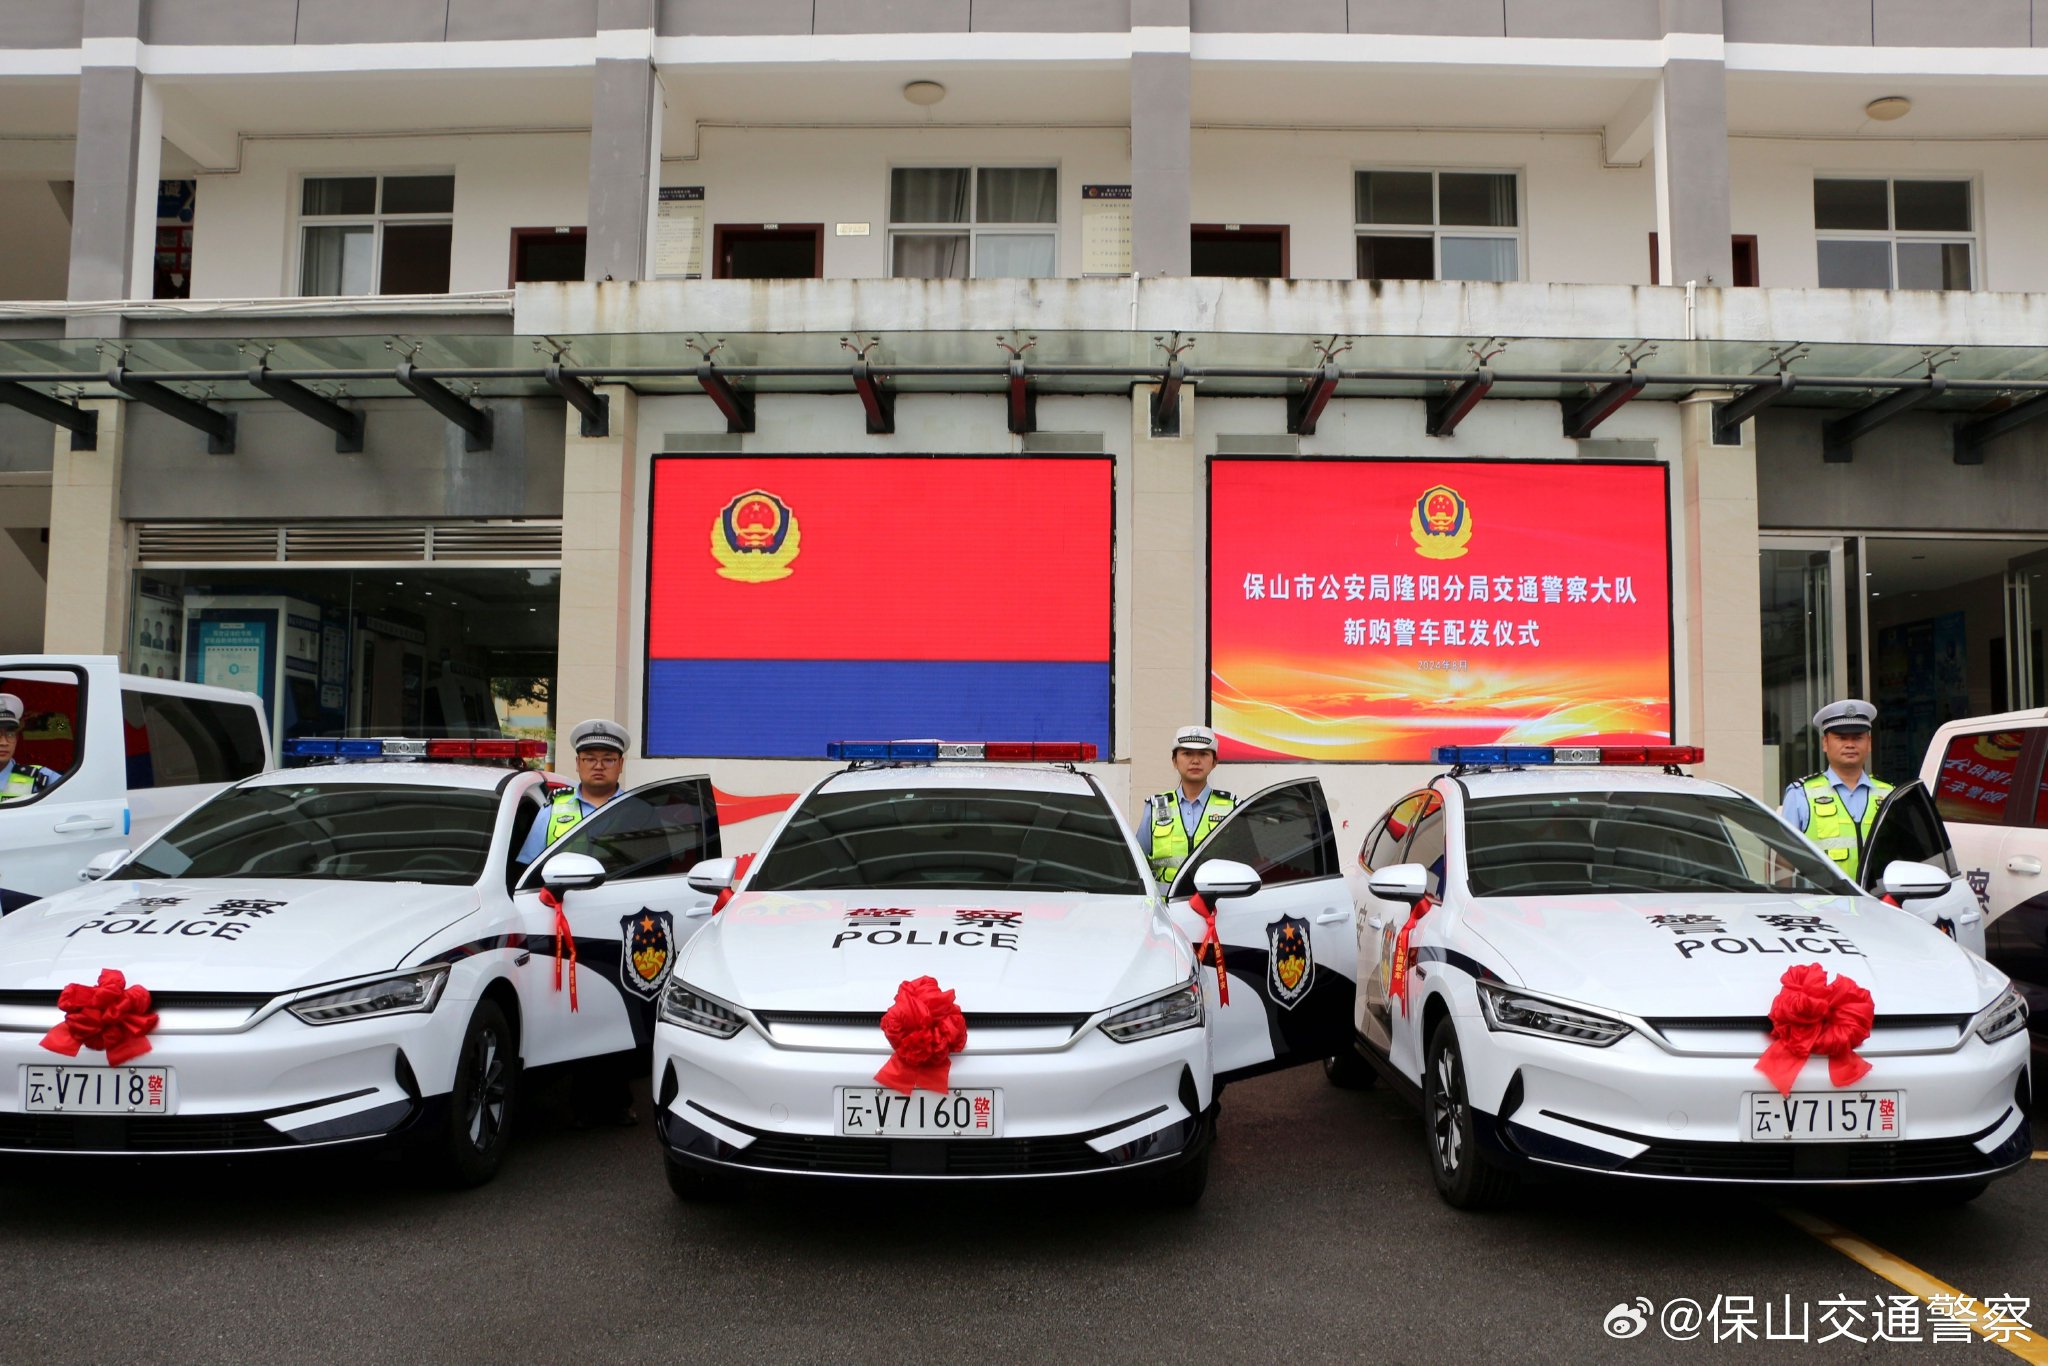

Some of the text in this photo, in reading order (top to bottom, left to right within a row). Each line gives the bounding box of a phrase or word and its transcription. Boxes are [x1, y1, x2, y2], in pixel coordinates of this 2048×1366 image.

[1243, 573, 1637, 604] 保山市公安局隆阳分局交通警察大队
[1344, 618, 1540, 647] 新购警车配发仪式
[103, 897, 288, 918] 警察
[845, 908, 1023, 929] 警察
[1646, 914, 1840, 935] 警察
[66, 919, 251, 940] POLICE
[832, 931, 1018, 951] POLICE
[1674, 938, 1868, 959] POLICE
